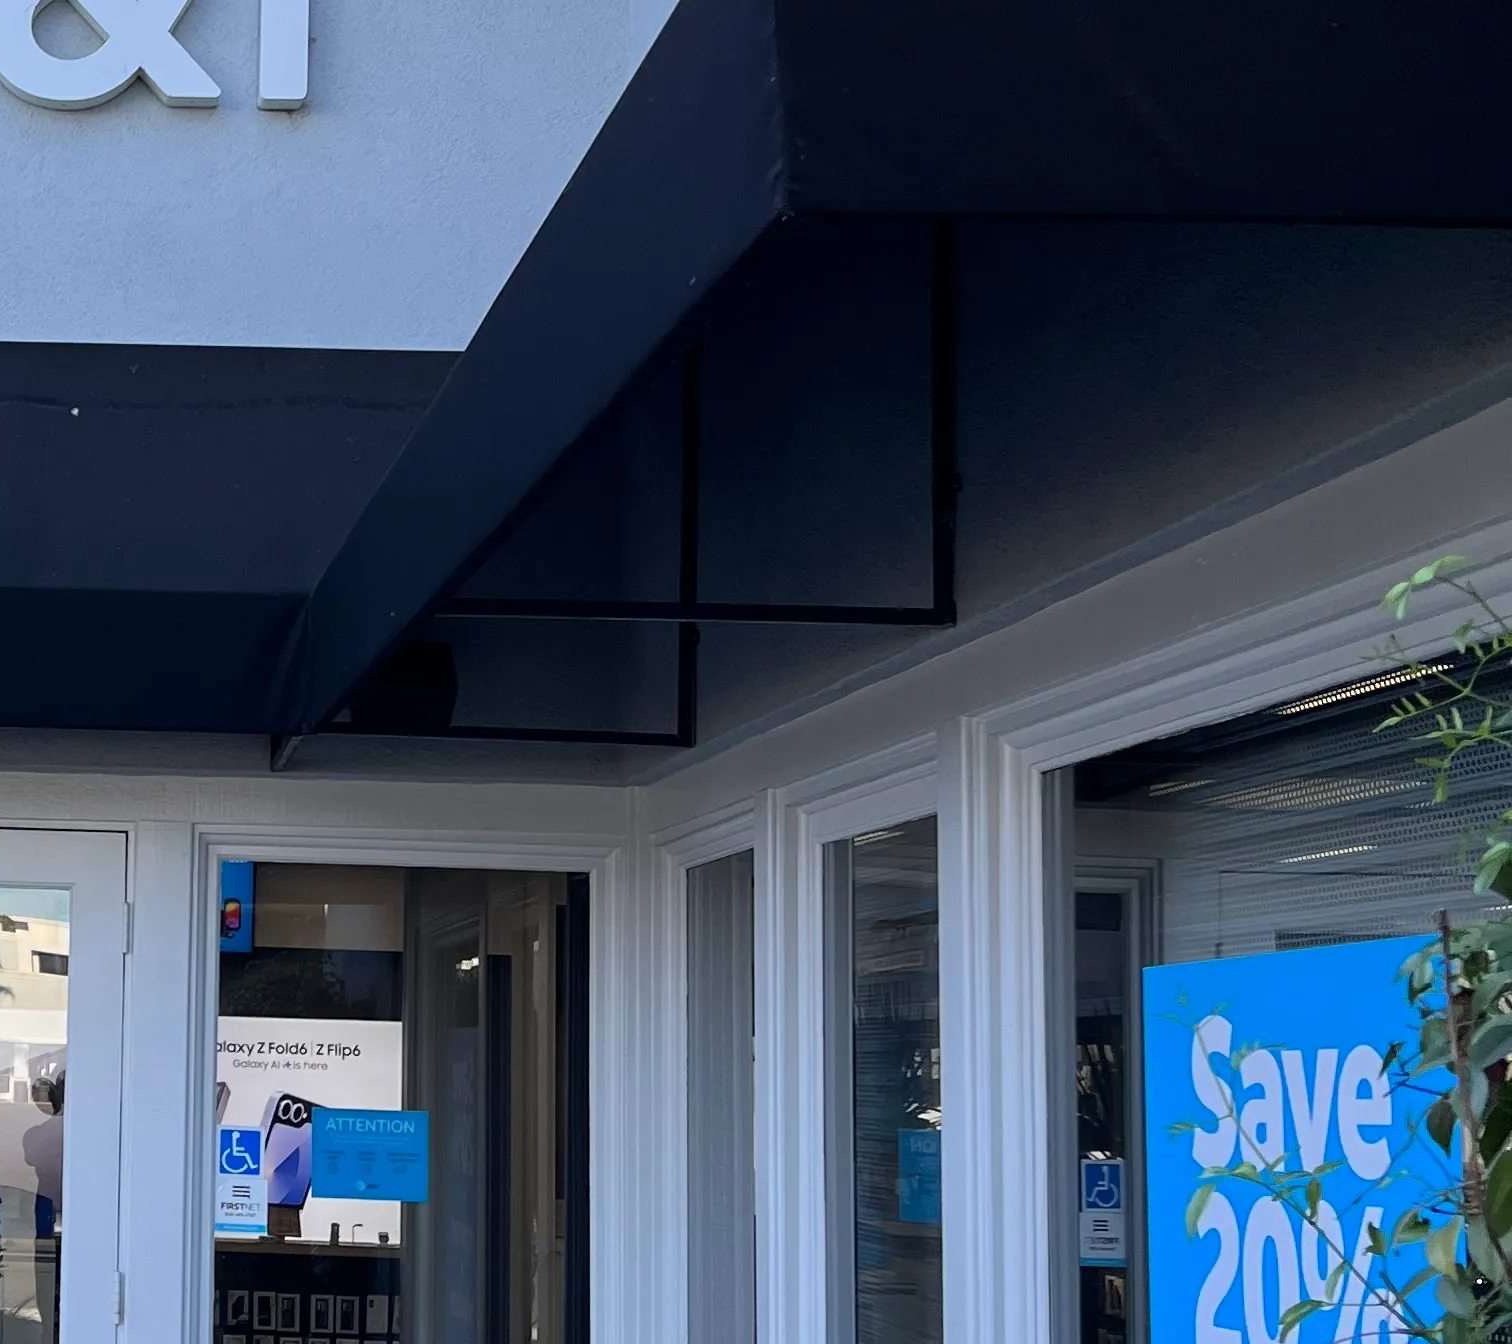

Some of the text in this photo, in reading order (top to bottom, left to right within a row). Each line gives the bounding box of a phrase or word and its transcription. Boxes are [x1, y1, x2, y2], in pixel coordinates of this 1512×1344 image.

[257, 1042, 266, 1054] Z
[268, 1041, 308, 1055] Fold6
[316, 1044, 324, 1056] Z
[327, 1043, 361, 1060] Flip6
[232, 1059, 268, 1071] Galaxy
[303, 1061, 329, 1071] here
[1192, 1015, 1392, 1181] Save
[326, 1117, 415, 1133] ATTENTION
